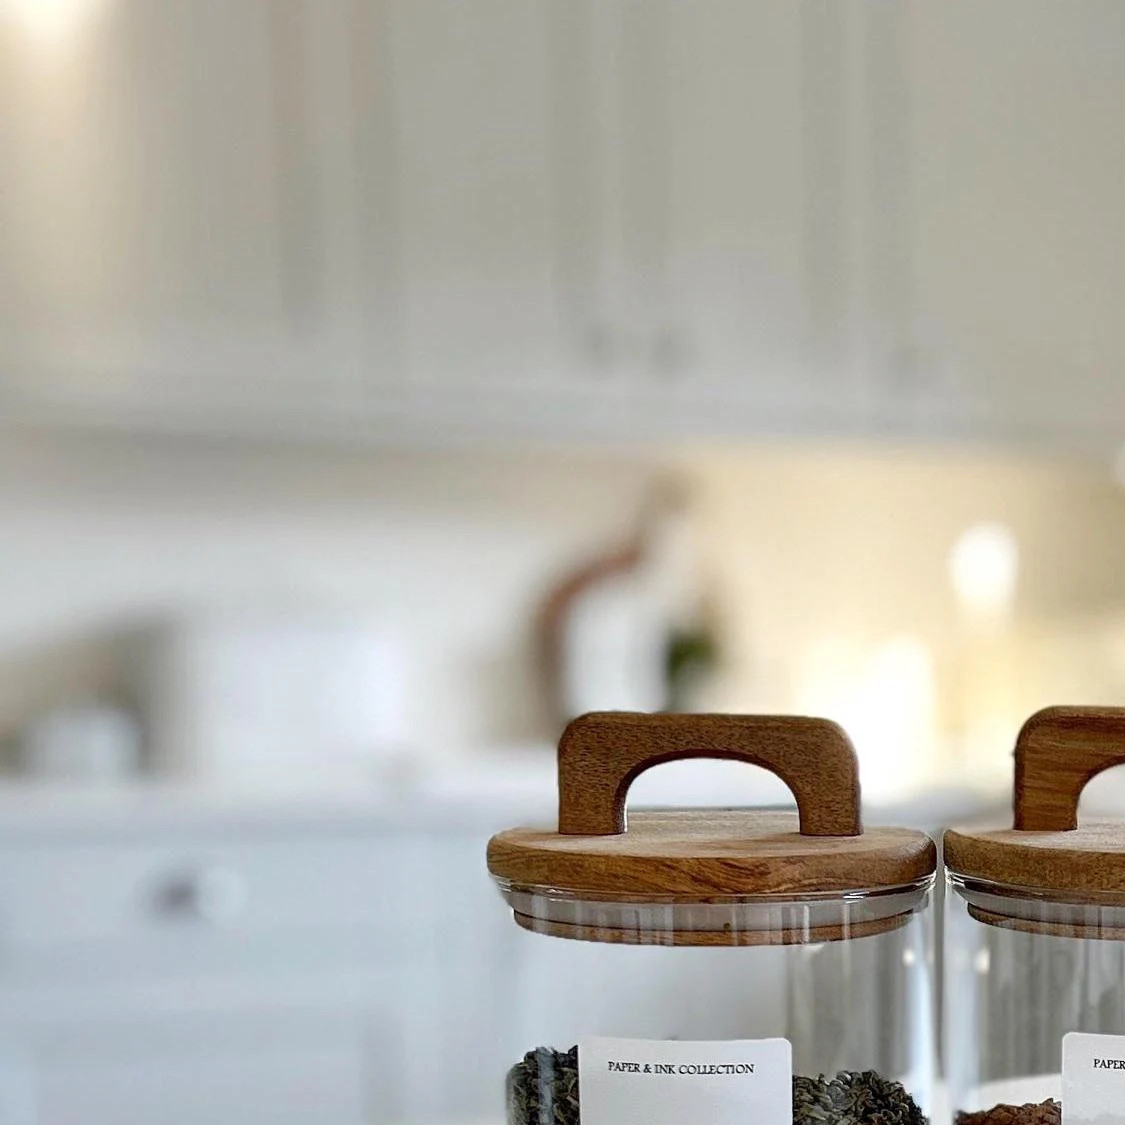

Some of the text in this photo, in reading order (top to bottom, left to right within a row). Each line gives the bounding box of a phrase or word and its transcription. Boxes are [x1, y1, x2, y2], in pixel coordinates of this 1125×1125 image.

[607, 1060, 756, 1075] PAPER & INK COLLECTION
